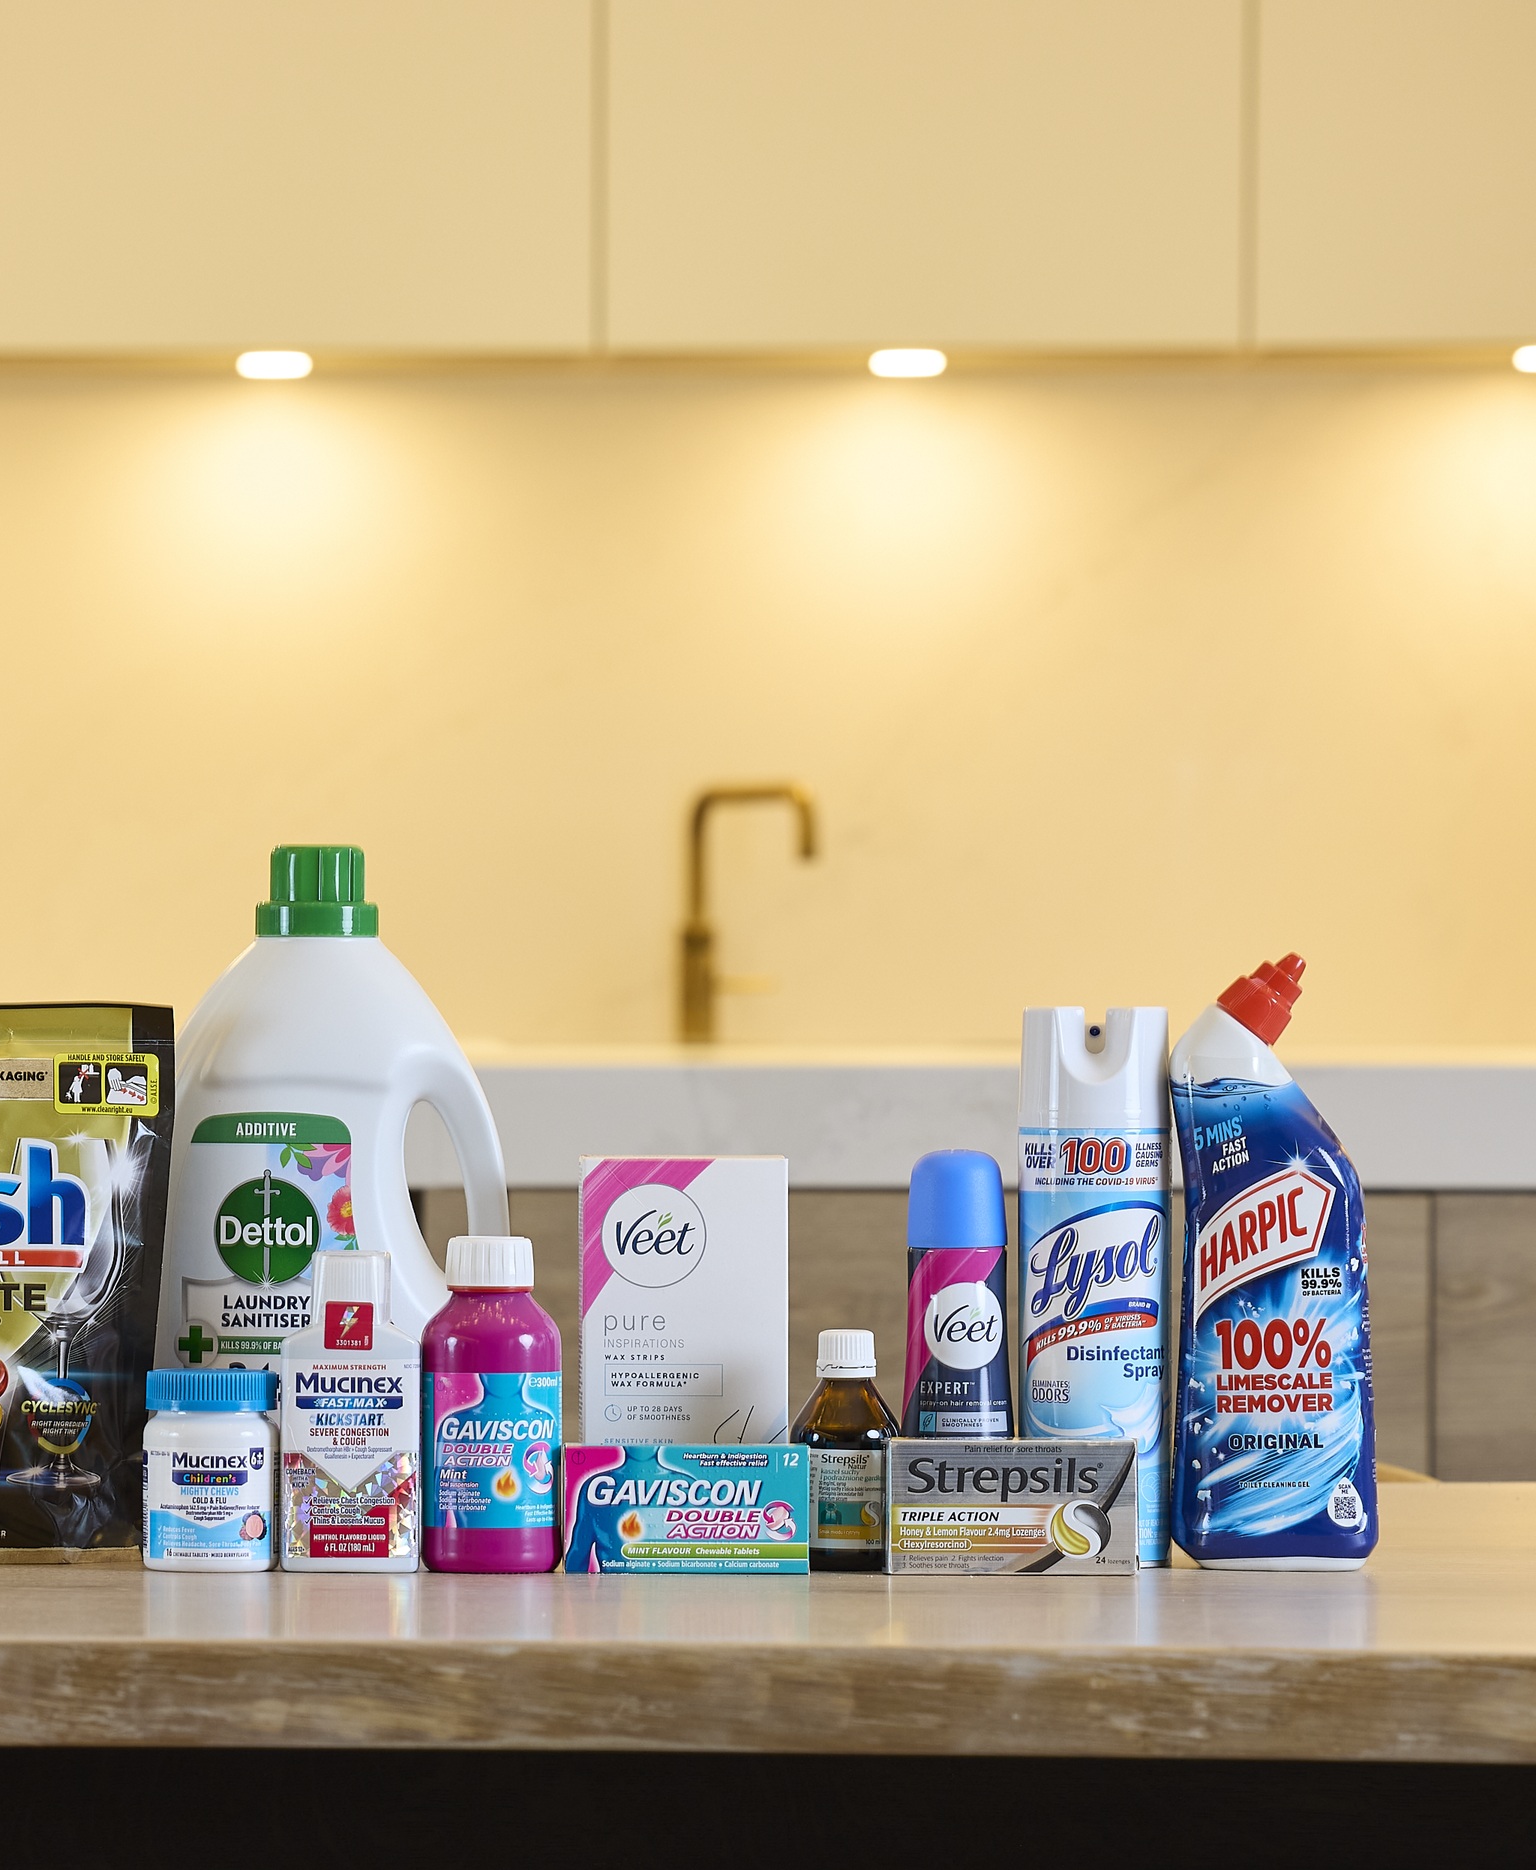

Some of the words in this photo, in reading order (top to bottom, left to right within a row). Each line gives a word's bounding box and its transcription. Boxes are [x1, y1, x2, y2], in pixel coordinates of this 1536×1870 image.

[67, 1053, 91, 1062] HANDLE
[91, 1054, 105, 1062] AND
[105, 1054, 125, 1062] STORE
[125, 1054, 146, 1063] SAFELY
[81, 1105, 133, 1115] www.cleanright.eu
[235, 1121, 297, 1137] ADDITIVE
[1135, 1142, 1162, 1151] ILLNESS
[1222, 1136, 1247, 1156] FAST
[1024, 1142, 1057, 1156] KILLS
[1061, 1139, 1128, 1175] 100
[1135, 1150, 1163, 1160] CAUSING
[1025, 1156, 1057, 1169] OVER
[1135, 1159, 1159, 1168] GERMS
[1212, 1149, 1250, 1175] ACTION
[219, 1215, 314, 1247] Dettol
[615, 1209, 696, 1256] Veet
[1200, 1186, 1308, 1292] HARPIC
[1030, 1214, 1161, 1322] Lysol
[1300, 1266, 1341, 1279] KILLS
[223, 1294, 312, 1310] LAUNDRY
[603, 1313, 666, 1337] pure
[933, 1304, 1000, 1343] Veet
[335, 1338, 362, 1348] 3301381
[603, 1338, 685, 1349] INSPIRATIONS
[1215, 1317, 1332, 1372] 100%
[630, 1353, 666, 1361] STRIPS
[1066, 1344, 1165, 1361] Disinfectant
[611, 1372, 700, 1380] HYPOALLERGENIC
[1123, 1363, 1165, 1382] Spray
[295, 1371, 404, 1395] Mucinex
[1216, 1372, 1333, 1391] LIMESCALE
[20, 1399, 98, 1415] CYCLESYNC
[1216, 1392, 1334, 1414] REMOVER
[315, 1412, 385, 1427] KICKSTART
[309, 1427, 340, 1438] SEVERE
[340, 1427, 391, 1438] CONGESTION
[441, 1417, 555, 1442] GAVISCON
[332, 1437, 339, 1446] &
[339, 1437, 367, 1447] COUGH
[1229, 1433, 1324, 1451] ORIGINAL
[442, 1443, 513, 1455] DOUBLE
[964, 1445, 981, 1453] Pain
[982, 1445, 1003, 1453] relief
[1004, 1445, 1015, 1453] for
[1035, 1445, 1063, 1453] throats
[172, 1451, 247, 1469] Mucinex
[443, 1455, 513, 1467] ACTION
[782, 1453, 799, 1468] 12
[820, 1453, 868, 1466] Strepsils
[183, 1472, 238, 1484] Children's
[285, 1468, 316, 1476] COMEBACK
[439, 1469, 468, 1481] Mint
[907, 1456, 1100, 1503] Strepsils
[180, 1486, 210, 1497] MIGHTY
[210, 1486, 240, 1497] CHEWS
[586, 1475, 763, 1507] GAVISCON
[192, 1496, 209, 1505] COLD
[209, 1496, 215, 1505] &
[215, 1496, 227, 1505] FLU
[313, 1506, 340, 1515] Controls
[340, 1506, 361, 1516] Cough
[665, 1509, 762, 1524] DOUBLE
[901, 1511, 946, 1522] TRIPLE
[947, 1511, 1000, 1522] ACTION
[665, 1523, 762, 1540] ACTION
[627, 1547, 650, 1556] MINT
[651, 1547, 693, 1556] FLAVOUR
[695, 1547, 732, 1556] Chewable
[732, 1547, 761, 1556] Tablets
[903, 1540, 968, 1551] Hexylresorcinol
[602, 1560, 622, 1568] Sodium
[622, 1560, 651, 1570] alginate
[657, 1560, 681, 1568] Sodium
[681, 1560, 717, 1569] bicarbonate
[724, 1560, 749, 1569] Calcium
[749, 1560, 780, 1569] carbonate
[1095, 1556, 1106, 1564] 24
[1107, 1558, 1131, 1566] lozenges
